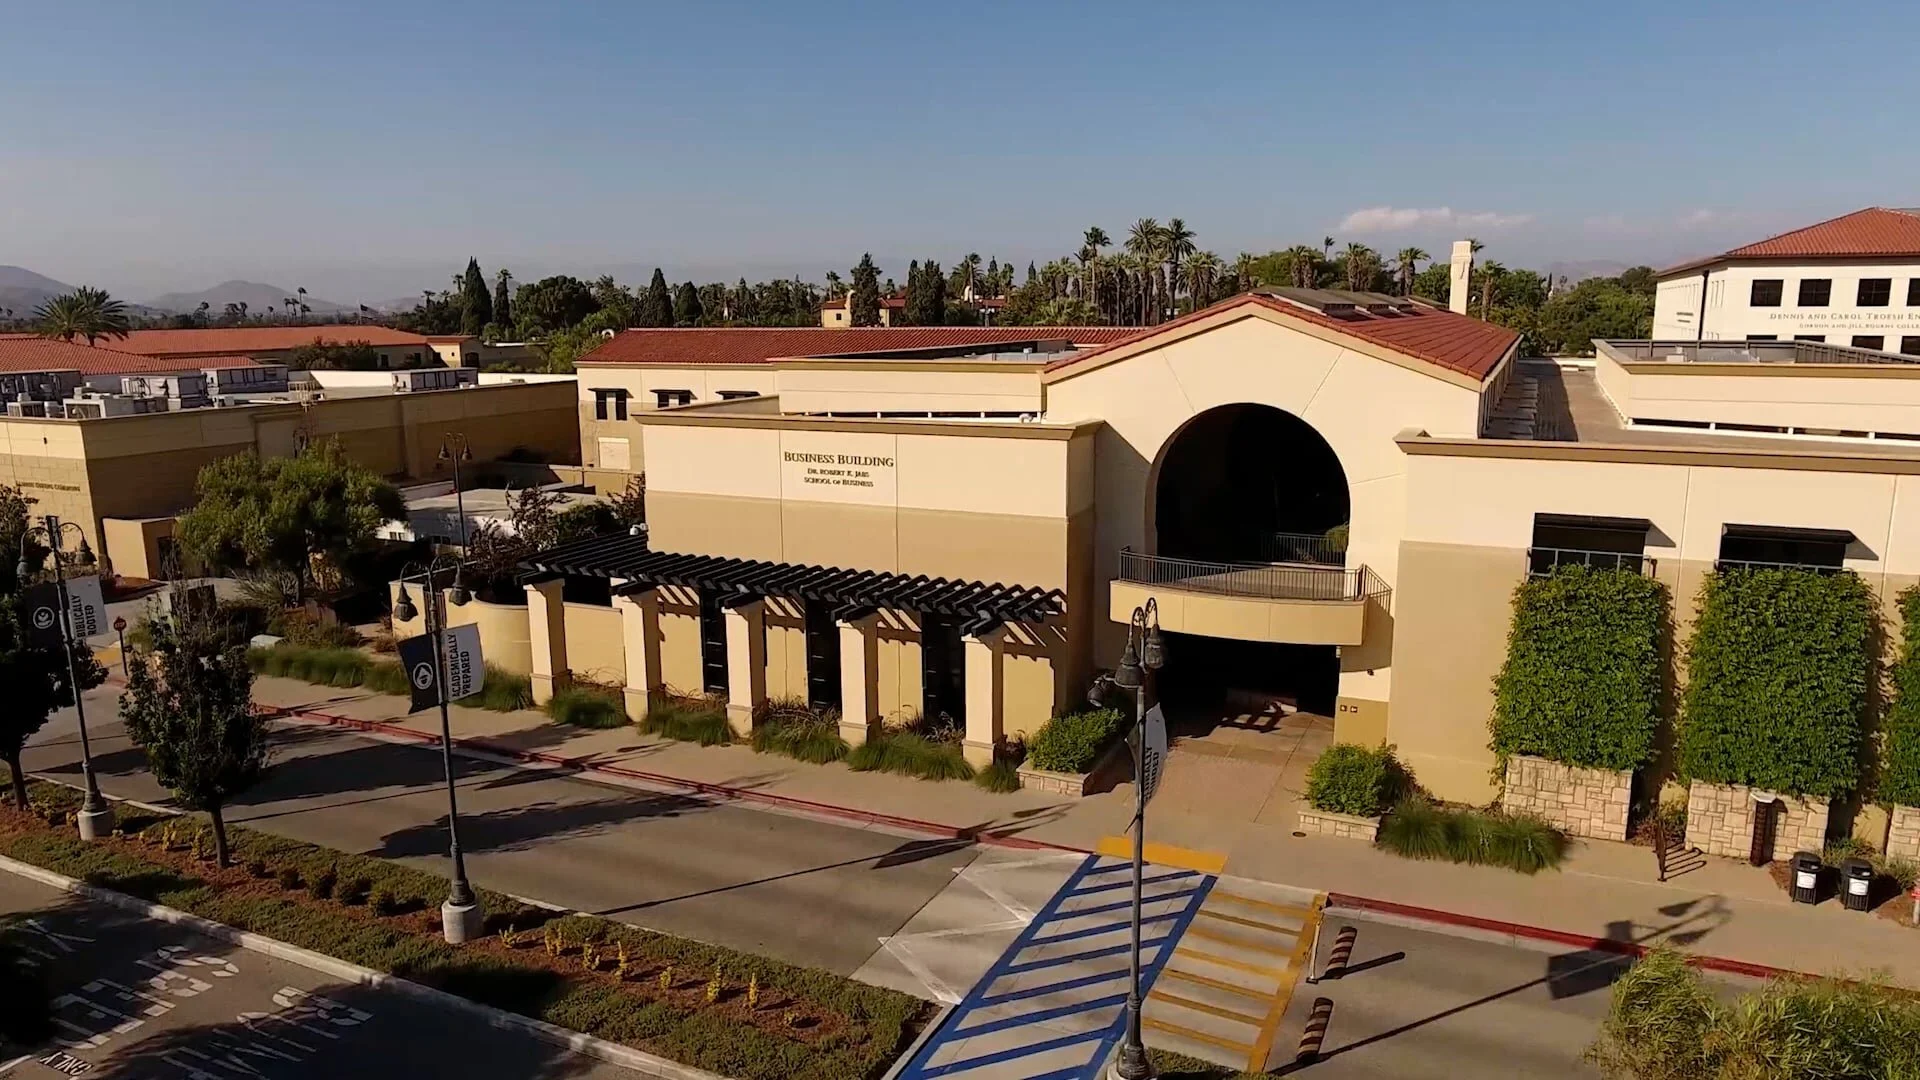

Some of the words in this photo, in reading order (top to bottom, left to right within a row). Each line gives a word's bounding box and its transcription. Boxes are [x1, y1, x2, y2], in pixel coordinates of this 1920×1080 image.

[784, 451, 835, 464] BUSINESS
[837, 454, 894, 467] BUILDING
[803, 477, 832, 485] SCHOOL
[842, 479, 874, 488] BUSINESS
[71, 594, 86, 638] BIBLICALLY
[84, 604, 97, 636] ROOTED
[448, 634, 460, 697] ACADEMICALLY
[460, 651, 472, 695] PREPARED
[39, 1051, 92, 1076] ONLY
